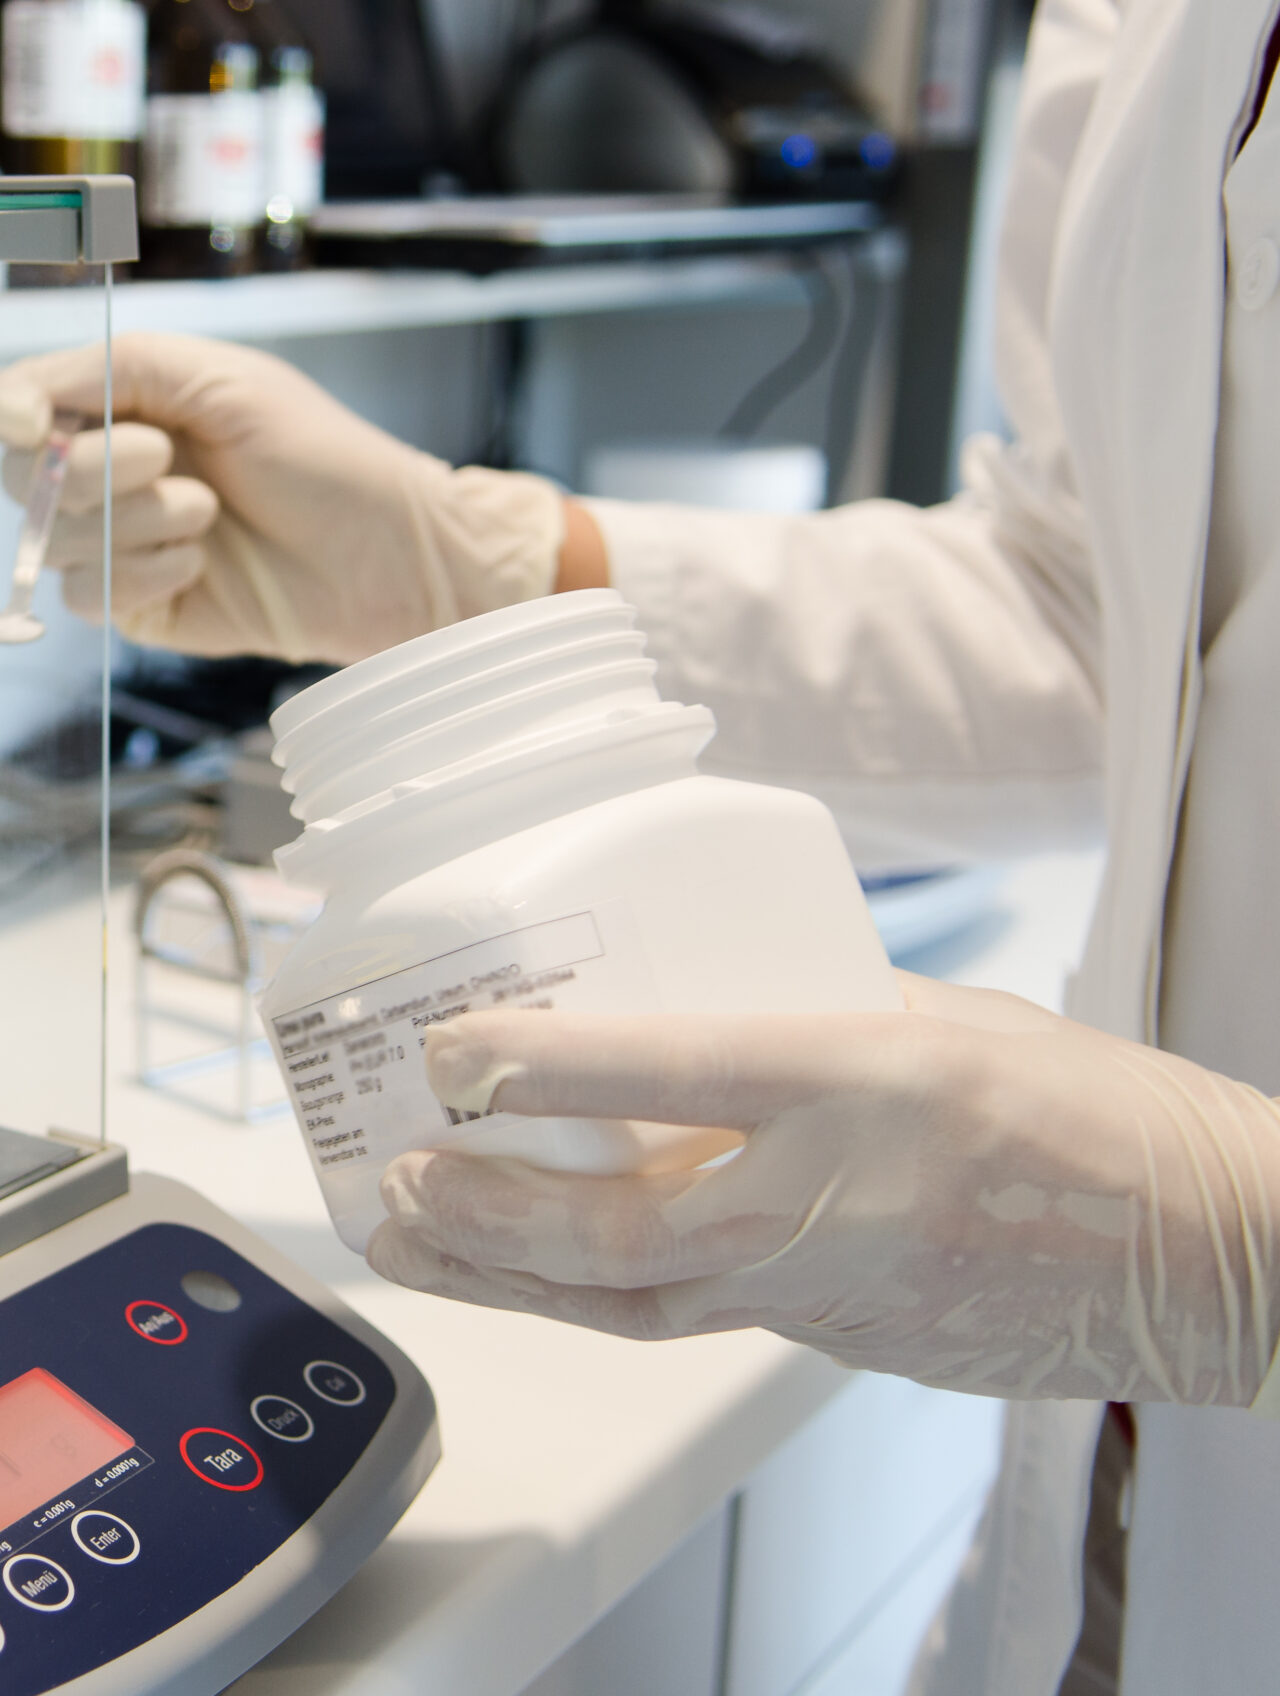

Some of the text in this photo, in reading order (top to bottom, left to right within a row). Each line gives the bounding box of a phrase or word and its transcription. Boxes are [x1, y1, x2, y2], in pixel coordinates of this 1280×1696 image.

[203, 1447, 243, 1473] Tara
[89, 1526, 122, 1552] Enter
[20, 1570, 59, 1598] Menü
